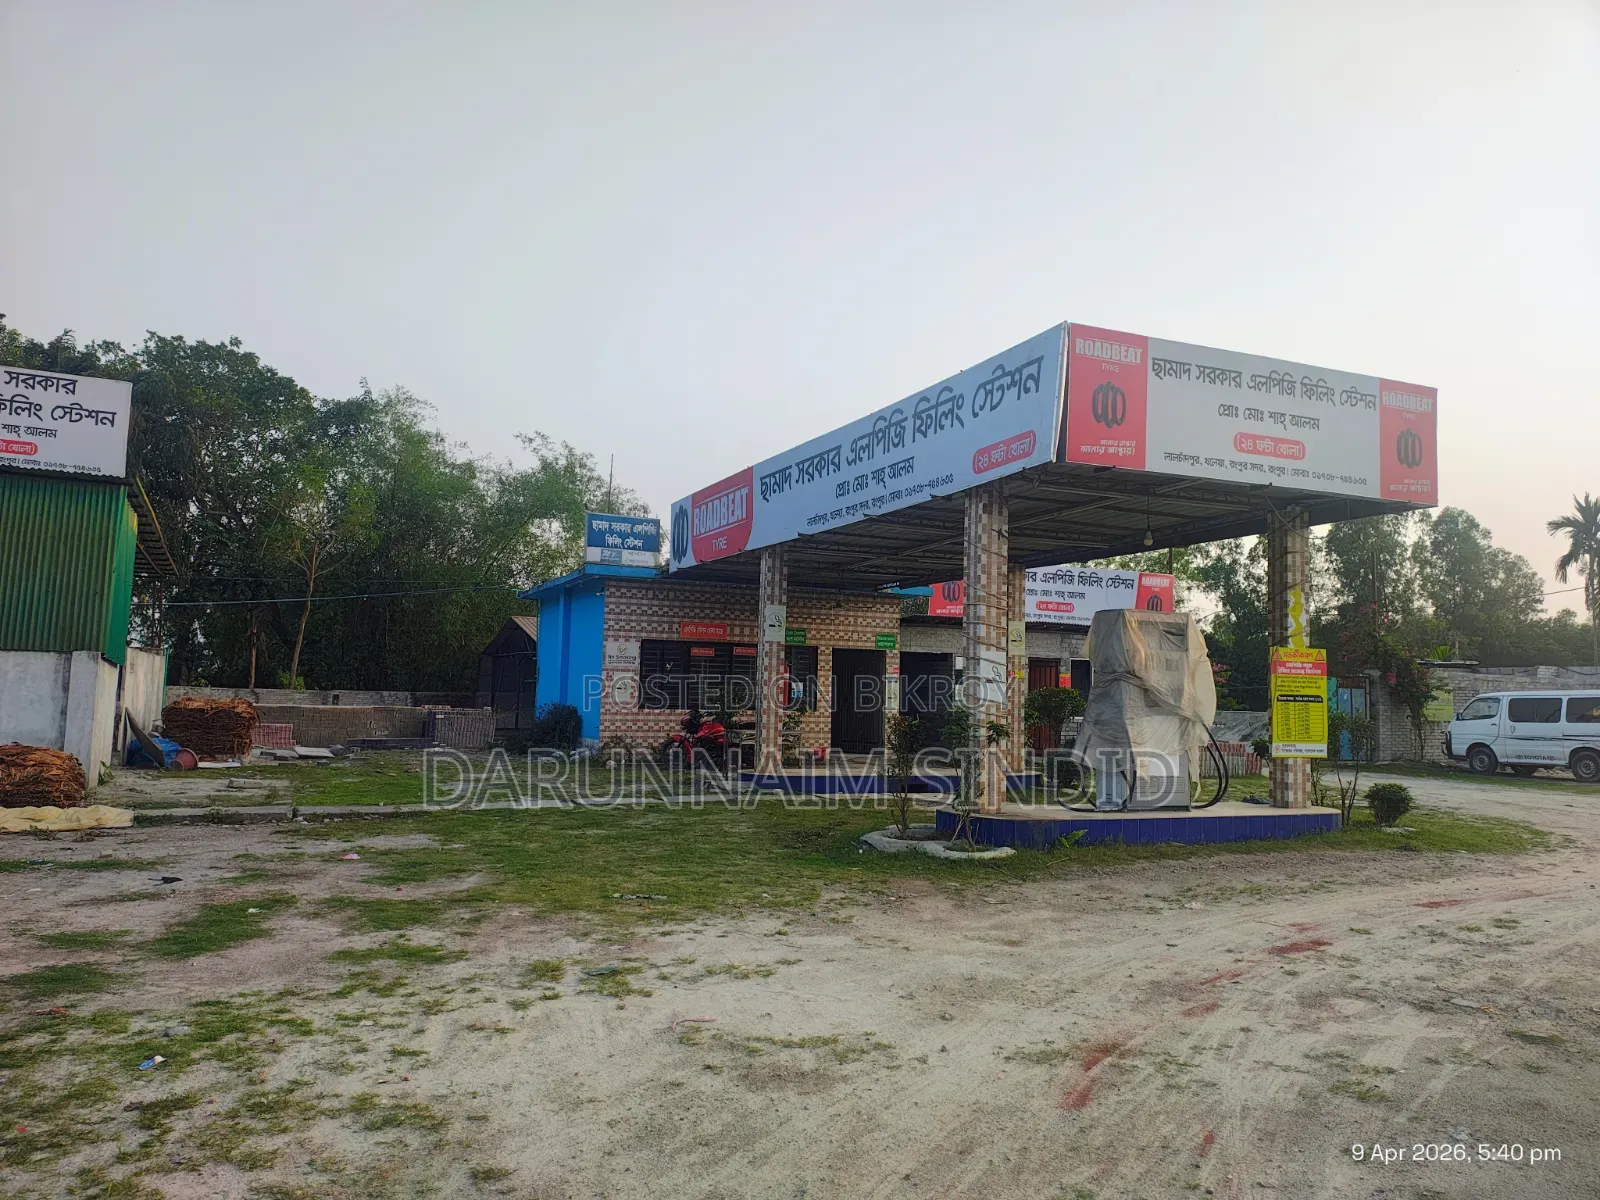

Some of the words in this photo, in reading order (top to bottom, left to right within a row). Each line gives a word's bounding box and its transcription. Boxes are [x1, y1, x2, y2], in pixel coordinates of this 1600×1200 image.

[1076, 337, 1142, 364] ROADBEAT
[1101, 363, 1120, 372] TYRE
[4, 371, 78, 395] সরকার
[1151, 357, 1192, 381] ছামাদ
[1195, 365, 1242, 389] সরকার
[1246, 370, 1296, 398] এলপিজি
[1300, 375, 1336, 407] ফিলিং
[1339, 386, 1377, 411] স্টেশন
[1382, 391, 1433, 413] ROADBEAT
[51, 403, 117, 427] স্টেশন
[1243, 407, 1264, 422] মোঃ
[1289, 414, 1320, 431] আলম
[24, 426, 58, 438] আলম
[759, 465, 793, 503] ছামাদ
[795, 444, 842, 485] সরকার
[846, 408, 908, 468] এলপিজি
[911, 385, 965, 443] ফিলিং
[972, 355, 1044, 418] স্টেশন
[975, 453, 989, 472] (২৪
[1008, 433, 1033, 458] খোলা)
[1237, 434, 1253, 451] (২৪
[1276, 443, 1303, 458] খোলা)
[852, 473, 869, 494] মোঃ
[887, 456, 915, 480] আলম
[693, 486, 748, 537] ROADBEAT
[712, 536, 727, 552] TYRE
[1040, 569, 1075, 587] এলপিজি
[1077, 572, 1103, 590] ফিলিং
[1106, 575, 1135, 590] স্টেশন
[1067, 591, 1086, 600] আলম
